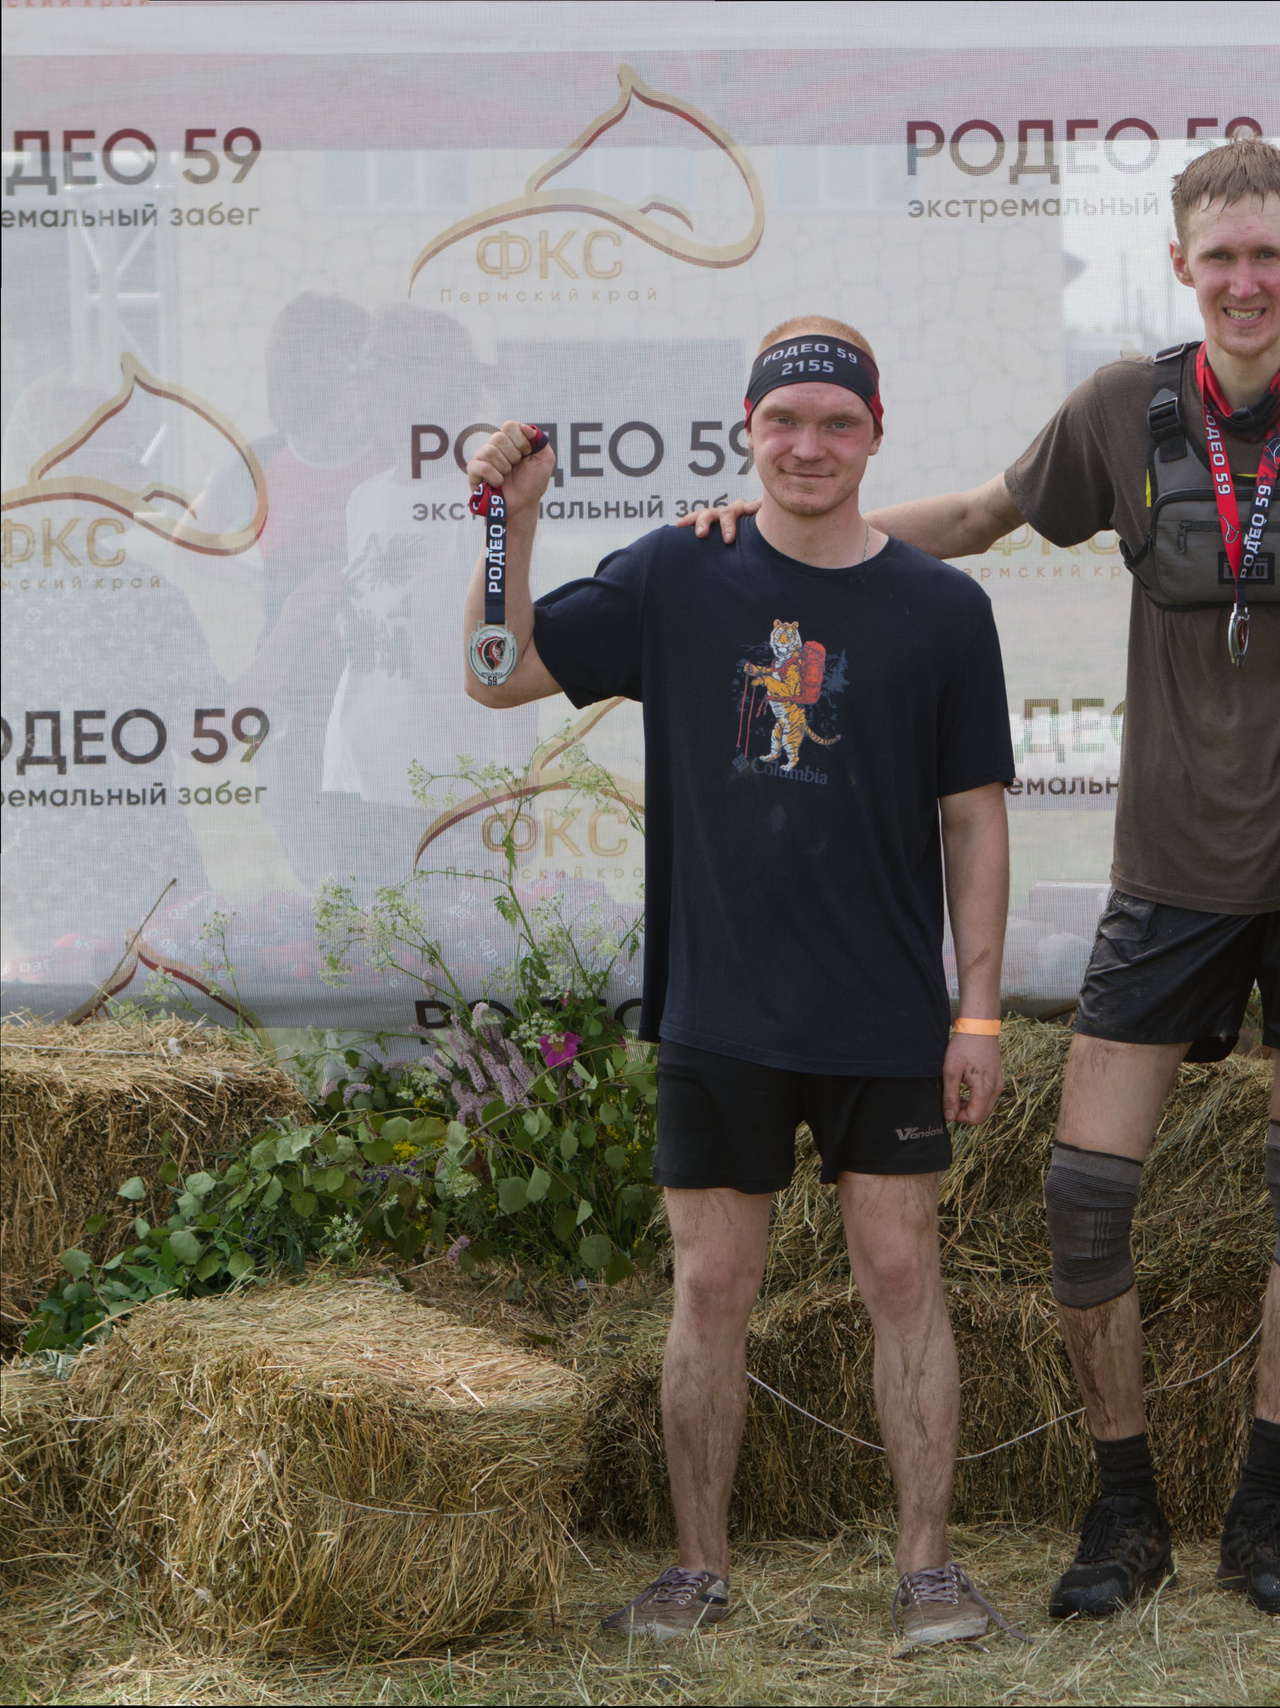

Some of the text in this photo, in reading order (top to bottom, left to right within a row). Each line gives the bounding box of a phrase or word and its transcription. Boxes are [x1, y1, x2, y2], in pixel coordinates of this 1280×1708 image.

[182, 127, 262, 184] 59
[906, 117, 1160, 185] РОДЕО
[170, 201, 260, 226] забег
[907, 193, 1158, 223] экстремальный
[476, 230, 623, 280] ФКС
[440, 287, 657, 305] Пермский край
[762, 343, 858, 367] РОДЕО 59
[781, 359, 834, 376] 2155
[1215, 472, 1231, 496] 59
[485, 494, 507, 593] РОДЕО 59
[1239, 512, 1268, 580] РОДЕО
[1255, 484, 1273, 508] 59
[95, 575, 161, 592] край
[487, 675, 498, 686] 59
[1, 706, 270, 775] ДЕО 59
[750, 757, 828, 785] Columbia
[1, 780, 267, 807] емальный забег
[481, 807, 628, 857] ФКС
